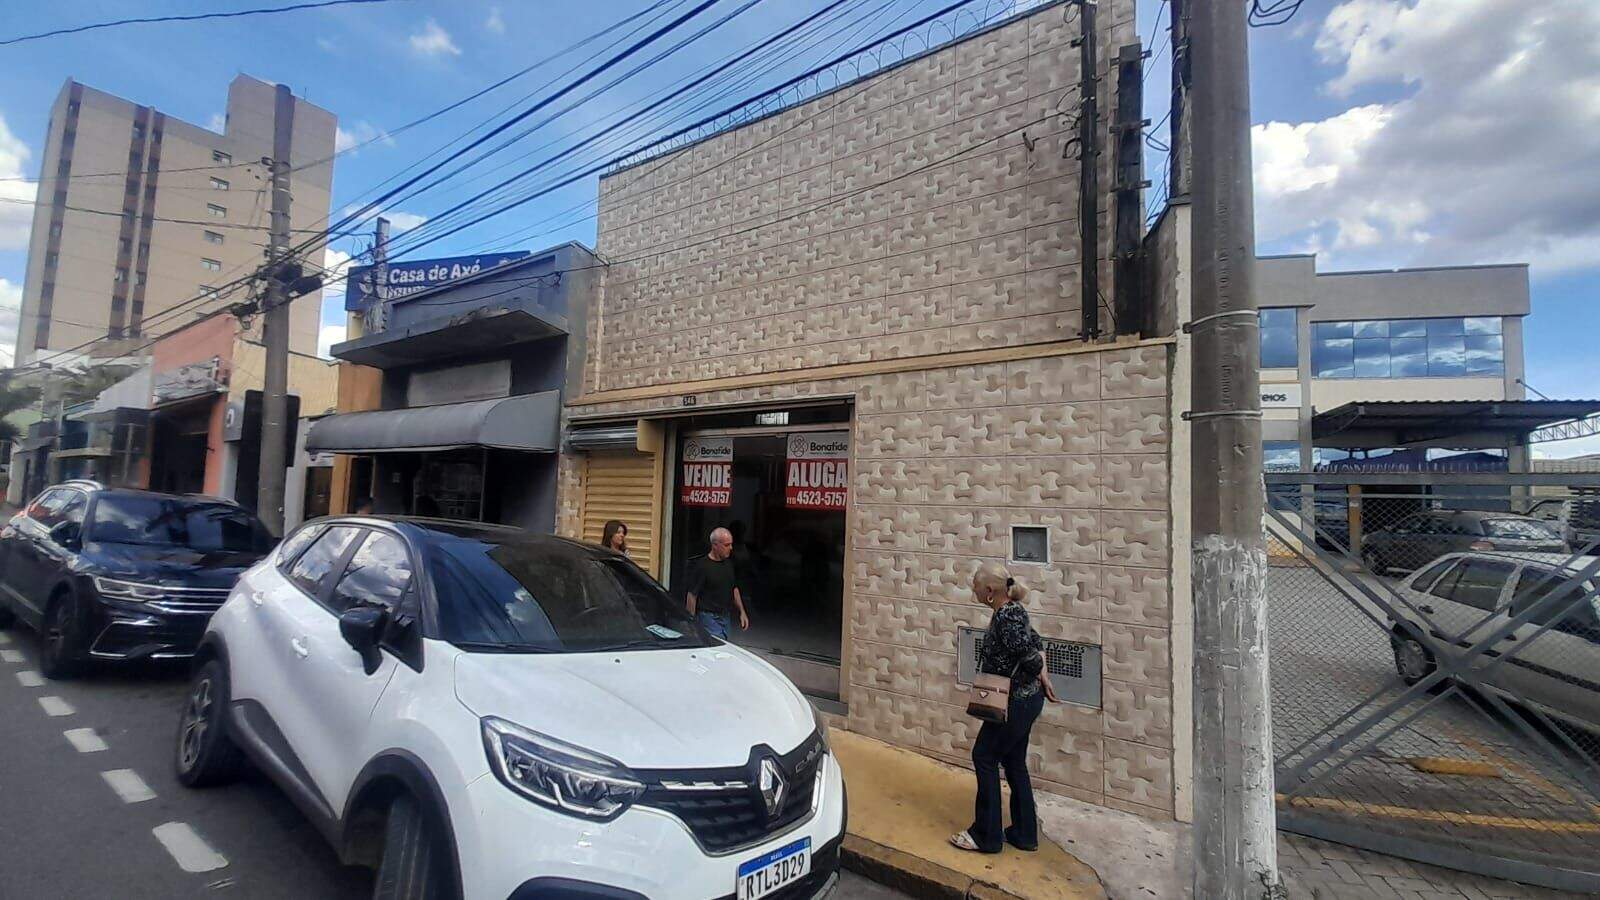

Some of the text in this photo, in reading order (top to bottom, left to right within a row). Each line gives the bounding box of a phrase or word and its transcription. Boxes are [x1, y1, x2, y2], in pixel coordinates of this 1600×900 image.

[390, 259, 480, 284] Casa de Axé
[1261, 393, 1287, 402] eios
[700, 446, 731, 455] Bonafide
[810, 441, 847, 451] Bonafide
[683, 464, 731, 488] VENDE
[787, 461, 848, 488] ALUGA
[690, 489, 730, 504] 4523-5757
[797, 490, 847, 506] 4523-5757
[1046, 642, 1085, 654] FUNDOS
[746, 852, 804, 900] RTL3D29
